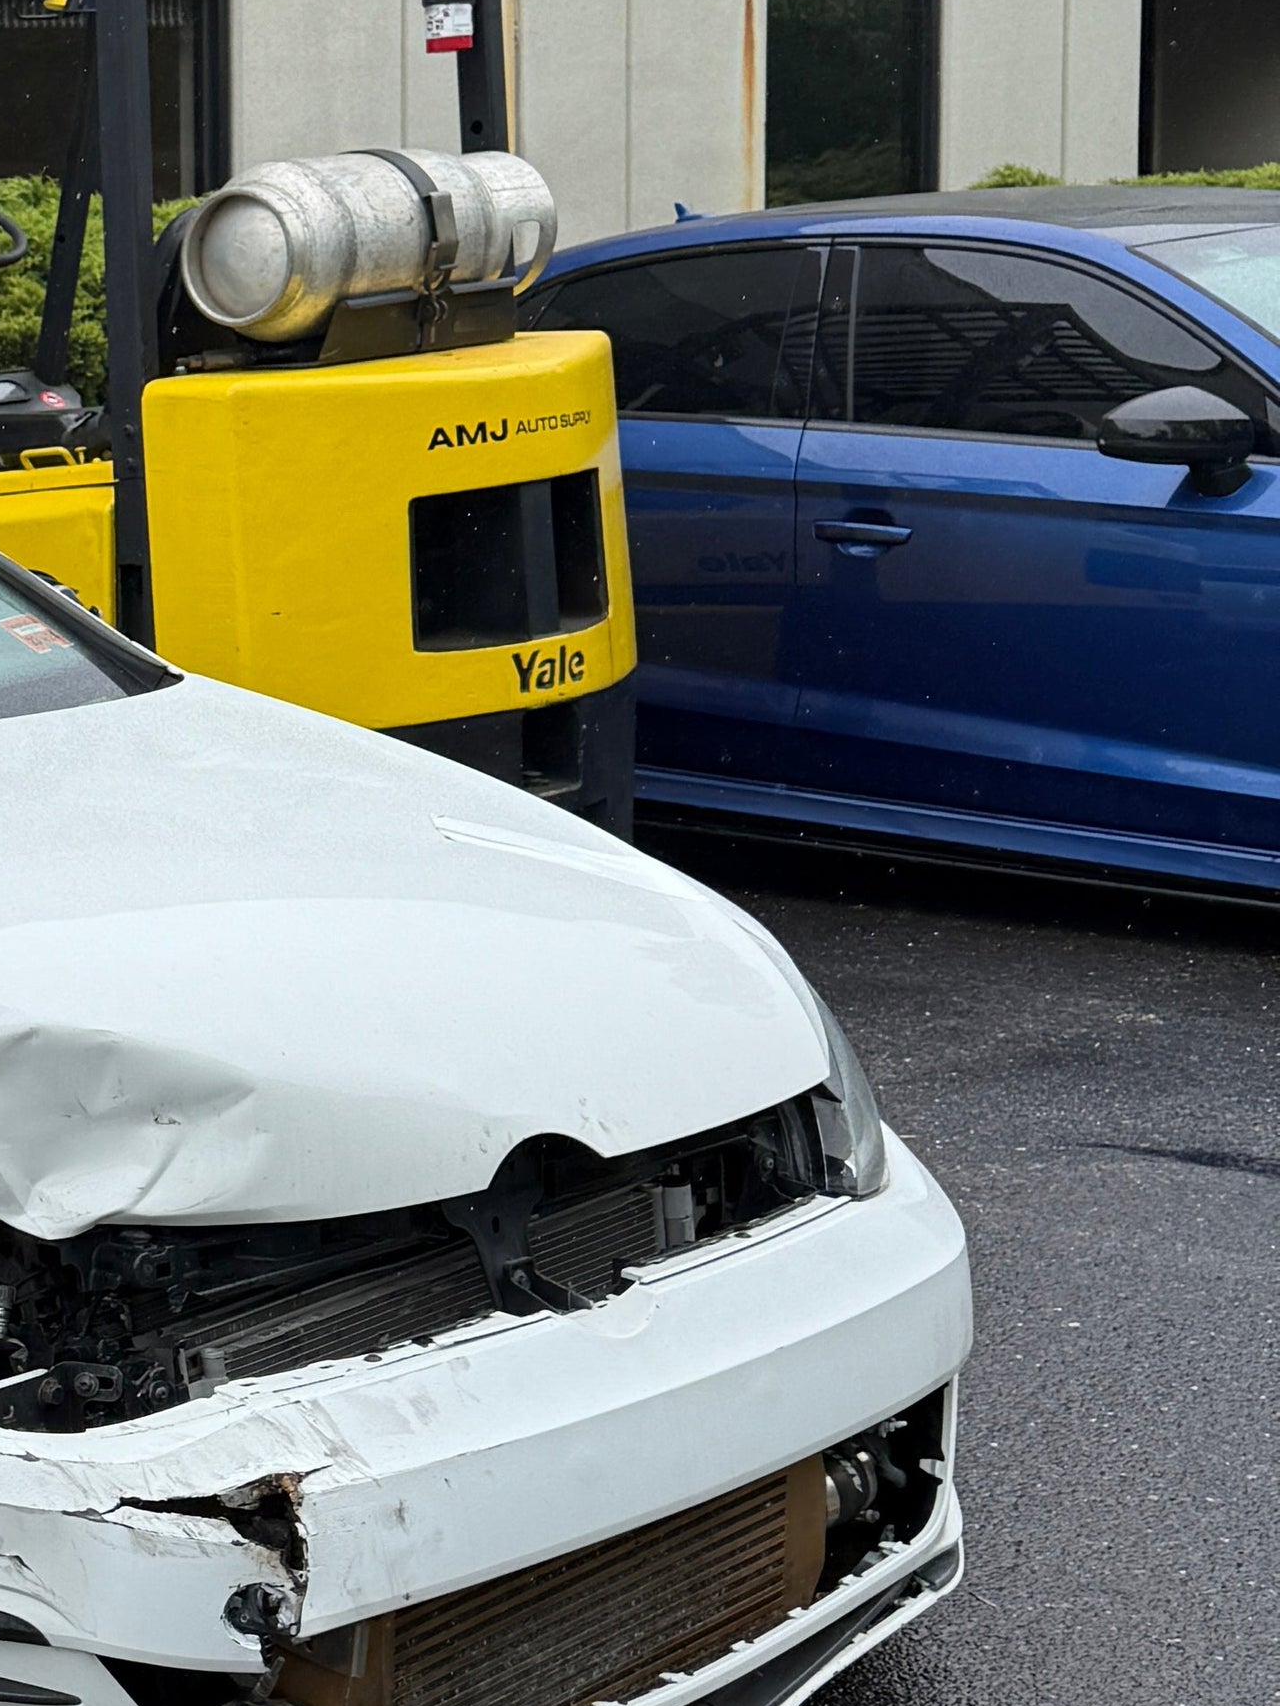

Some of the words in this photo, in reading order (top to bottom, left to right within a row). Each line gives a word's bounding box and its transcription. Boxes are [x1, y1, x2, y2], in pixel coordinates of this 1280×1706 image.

[427, 418, 508, 451] AMJ
[515, 415, 558, 436] AUTO
[560, 409, 592, 429] SUPPLY
[511, 644, 585, 694] Yale
